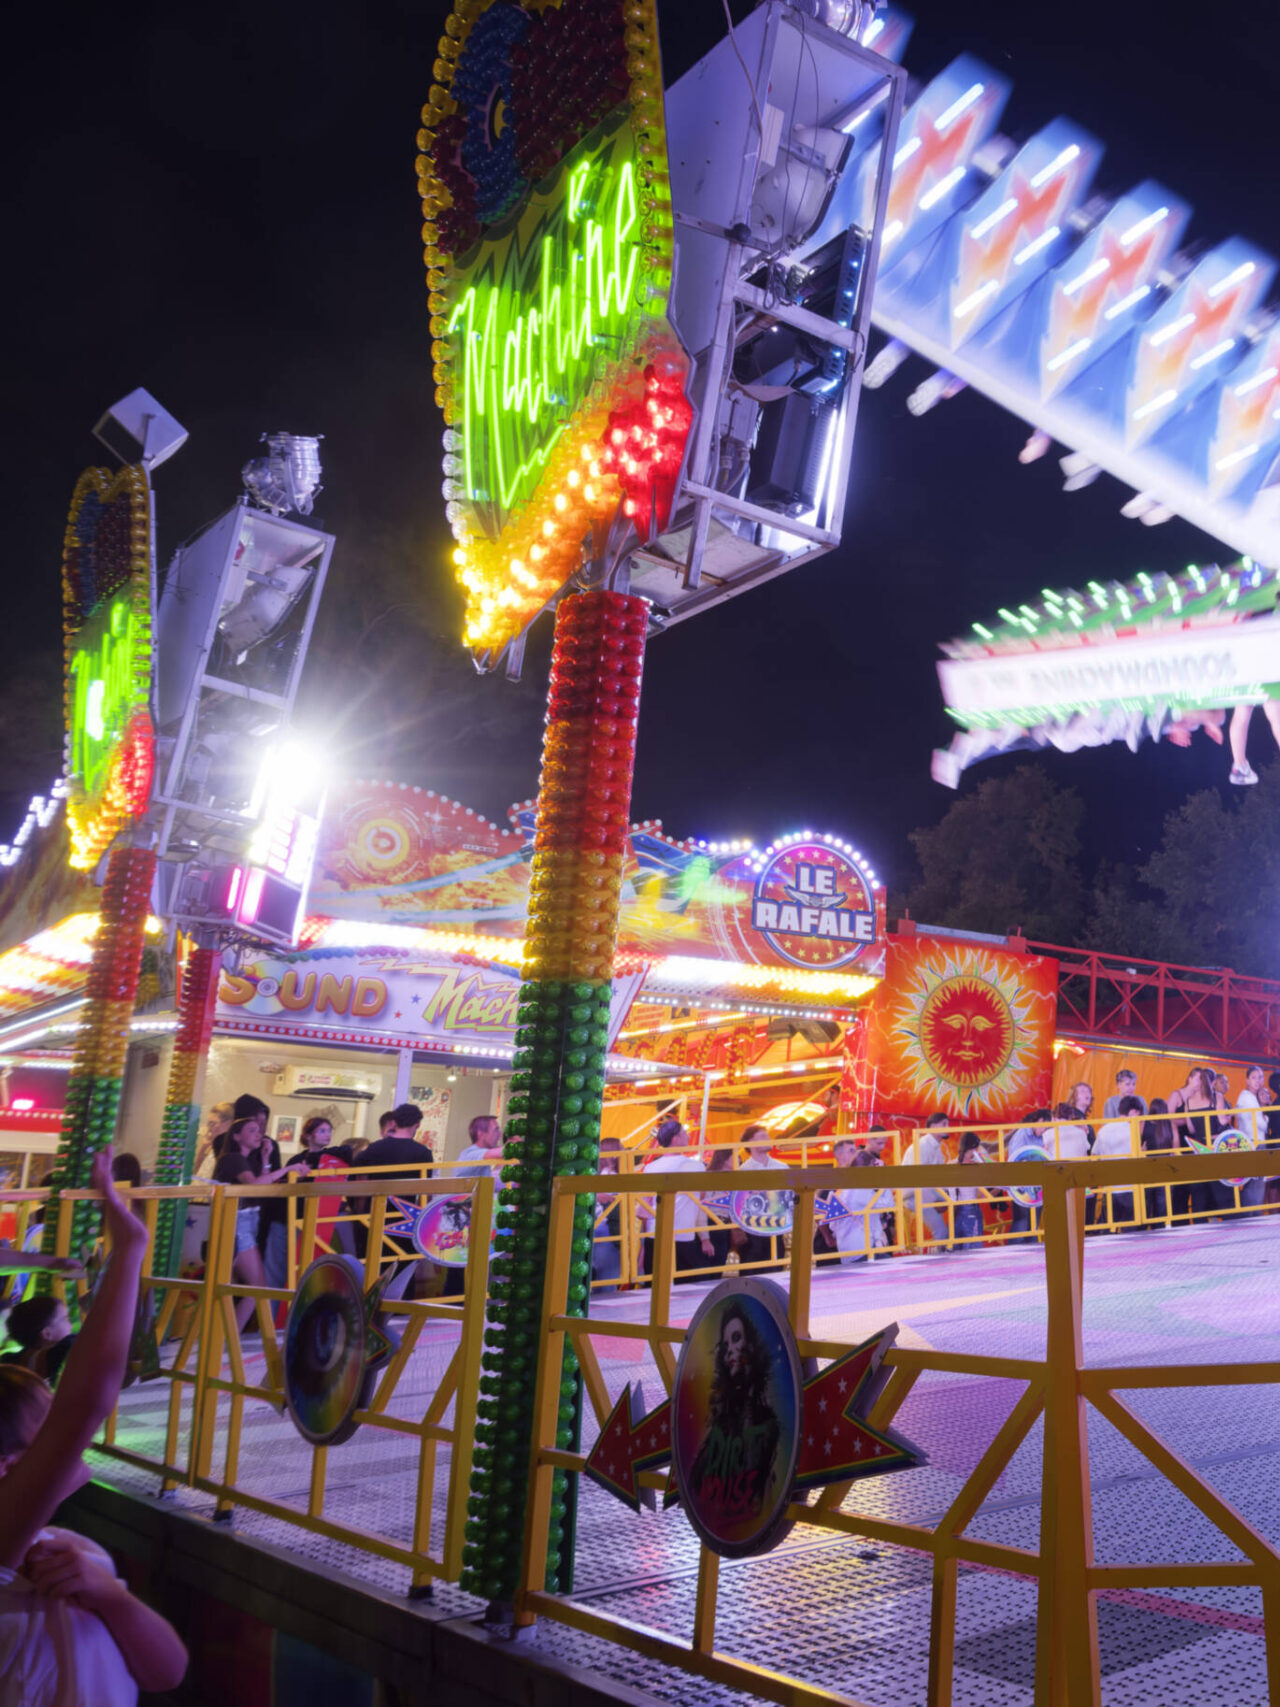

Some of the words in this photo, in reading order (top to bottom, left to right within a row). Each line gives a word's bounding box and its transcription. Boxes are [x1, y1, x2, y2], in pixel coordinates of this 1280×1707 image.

[797, 864, 836, 896] LE
[754, 900, 876, 942] RAFALE
[217, 969, 388, 1018] SOUND
